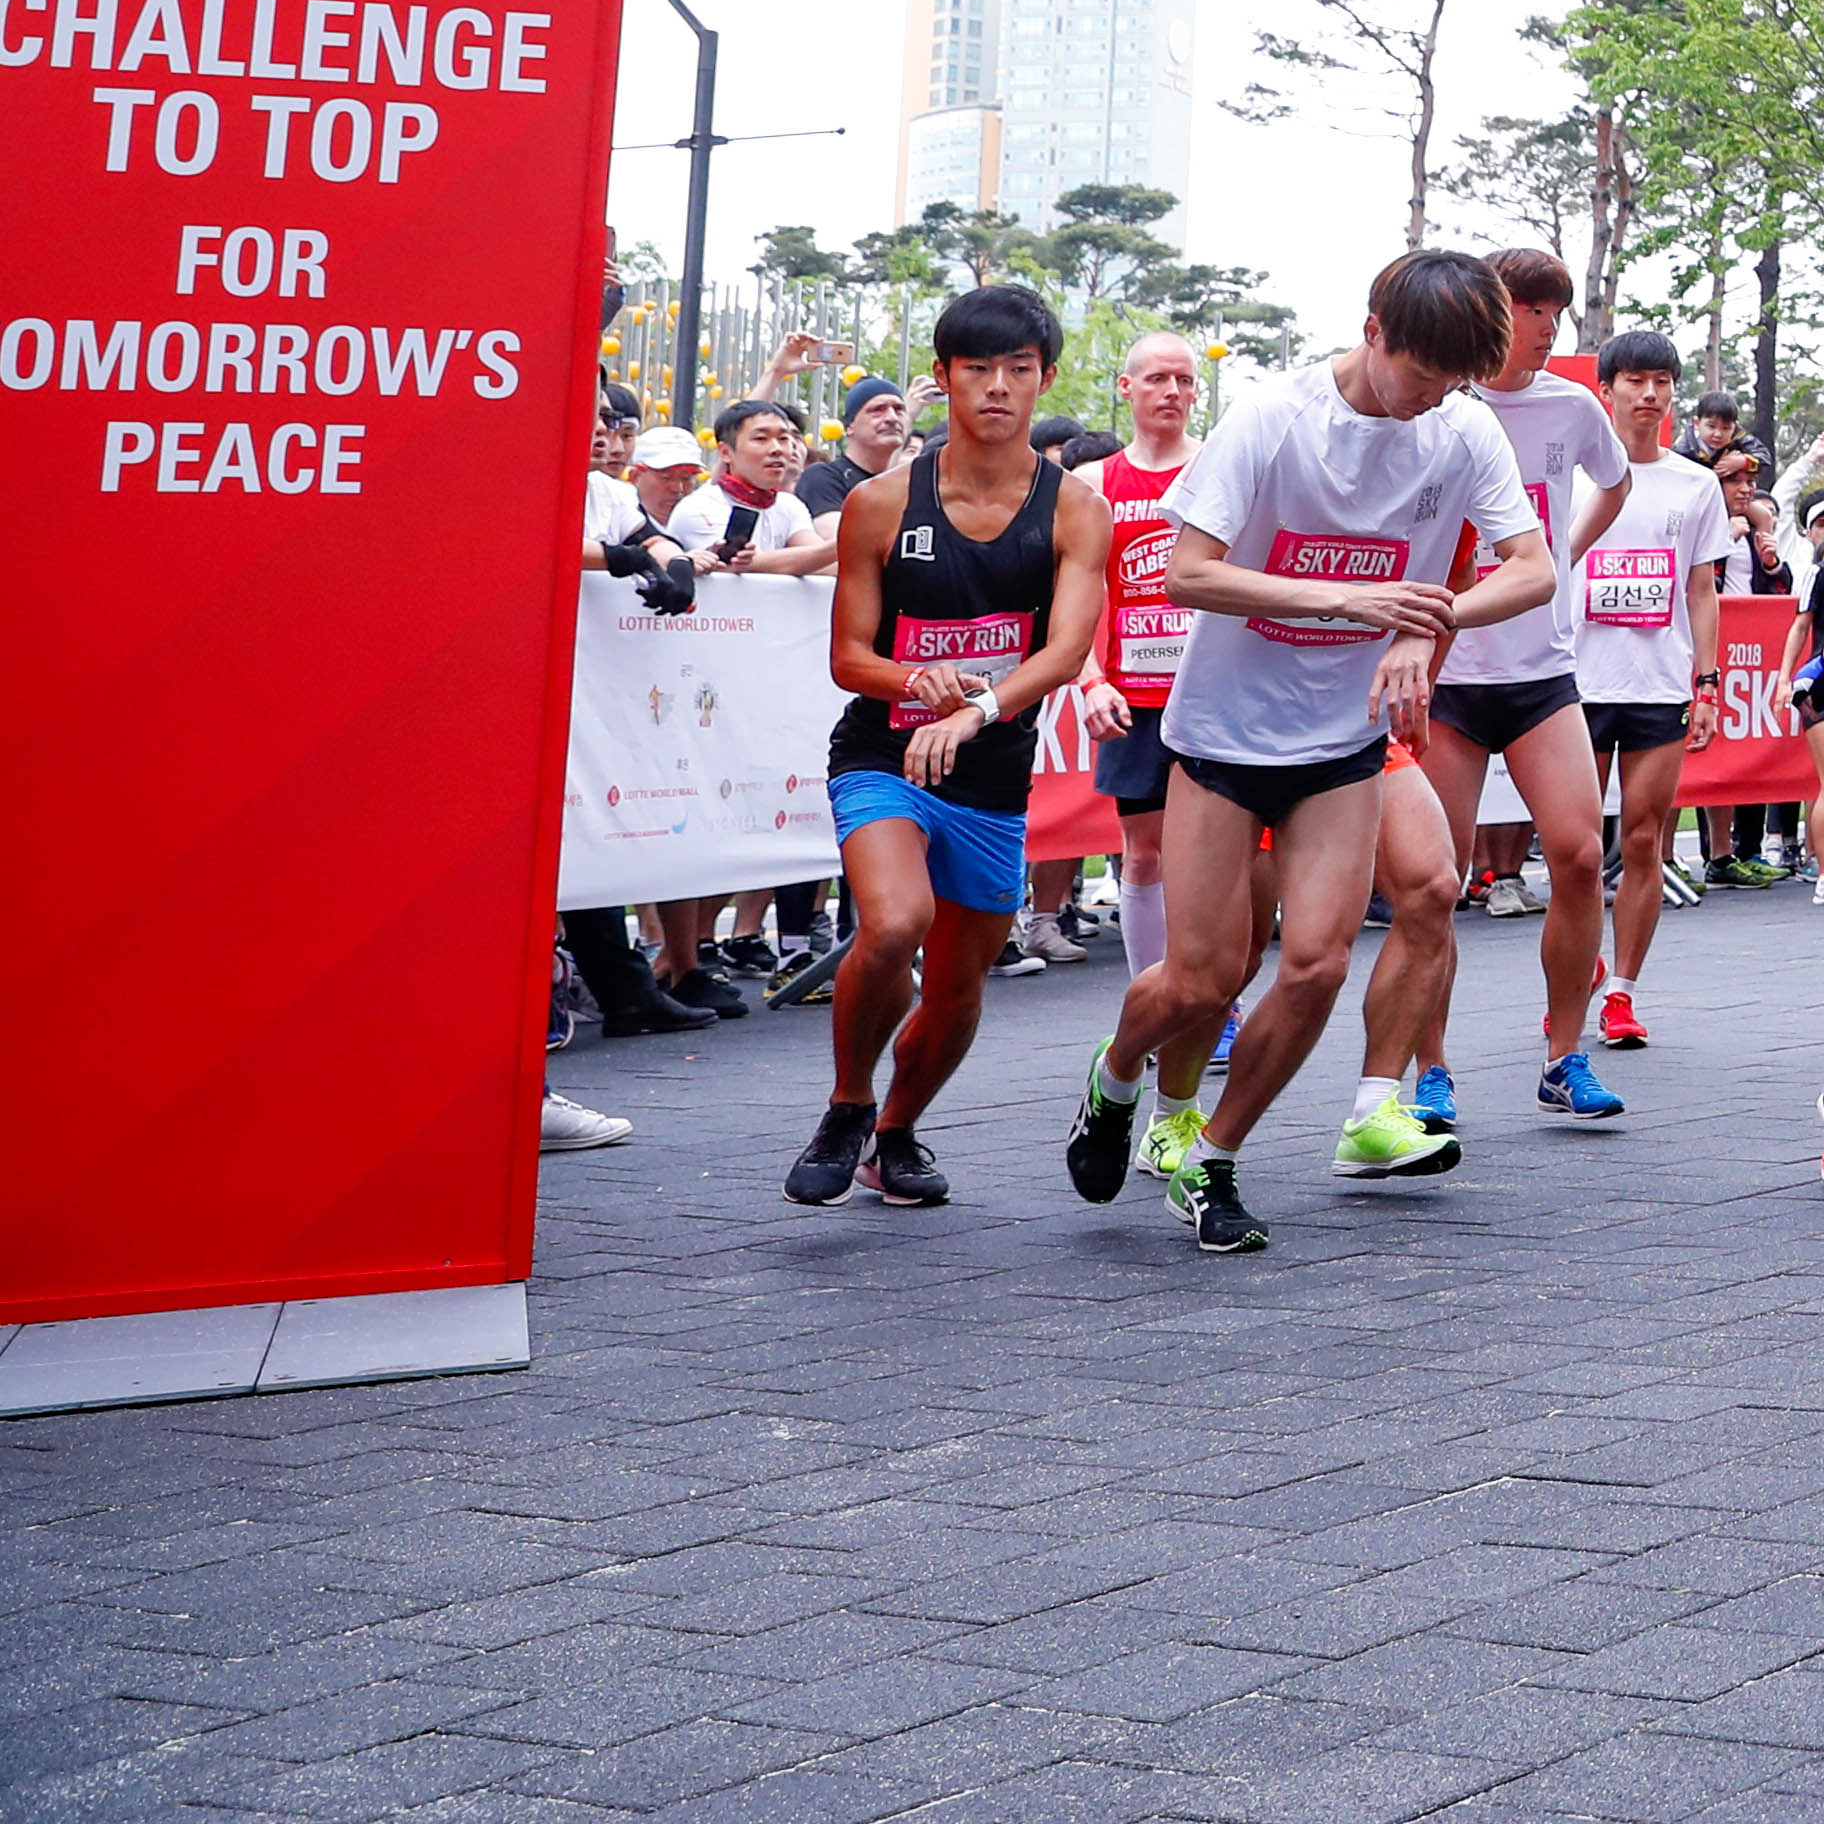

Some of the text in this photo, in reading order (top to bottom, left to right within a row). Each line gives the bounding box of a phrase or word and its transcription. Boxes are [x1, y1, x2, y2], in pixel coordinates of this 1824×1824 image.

[91, 86, 440, 184] TO TOP
[175, 224, 330, 300] FOR
[0, 316, 522, 400] OMORROW'S
[99, 420, 366, 495] PEACE
[1545, 453, 1564, 465] SKY
[1113, 499, 1165, 523] DENM
[1414, 507, 1438, 523] RUN
[1417, 497, 1440, 512] SKY
[1121, 534, 1178, 563] WEST COAS
[1126, 549, 1173, 581] LABE
[1294, 547, 1397, 577] SKY RUN
[1602, 555, 1669, 576] SKY RUN
[1599, 584, 1667, 608] 김선우
[618, 616, 755, 633] LOTTE WORLD TOWER
[1128, 613, 1194, 636] SKY RUN
[1258, 622, 1295, 639] LOTTE
[1294, 632, 1333, 642] WORLD
[918, 630, 970, 657] SKY
[973, 622, 1020, 652] RUN
[1727, 642, 1763, 667] 2018
[903, 713, 938, 723] LOTT
[1031, 684, 1091, 775] KY
